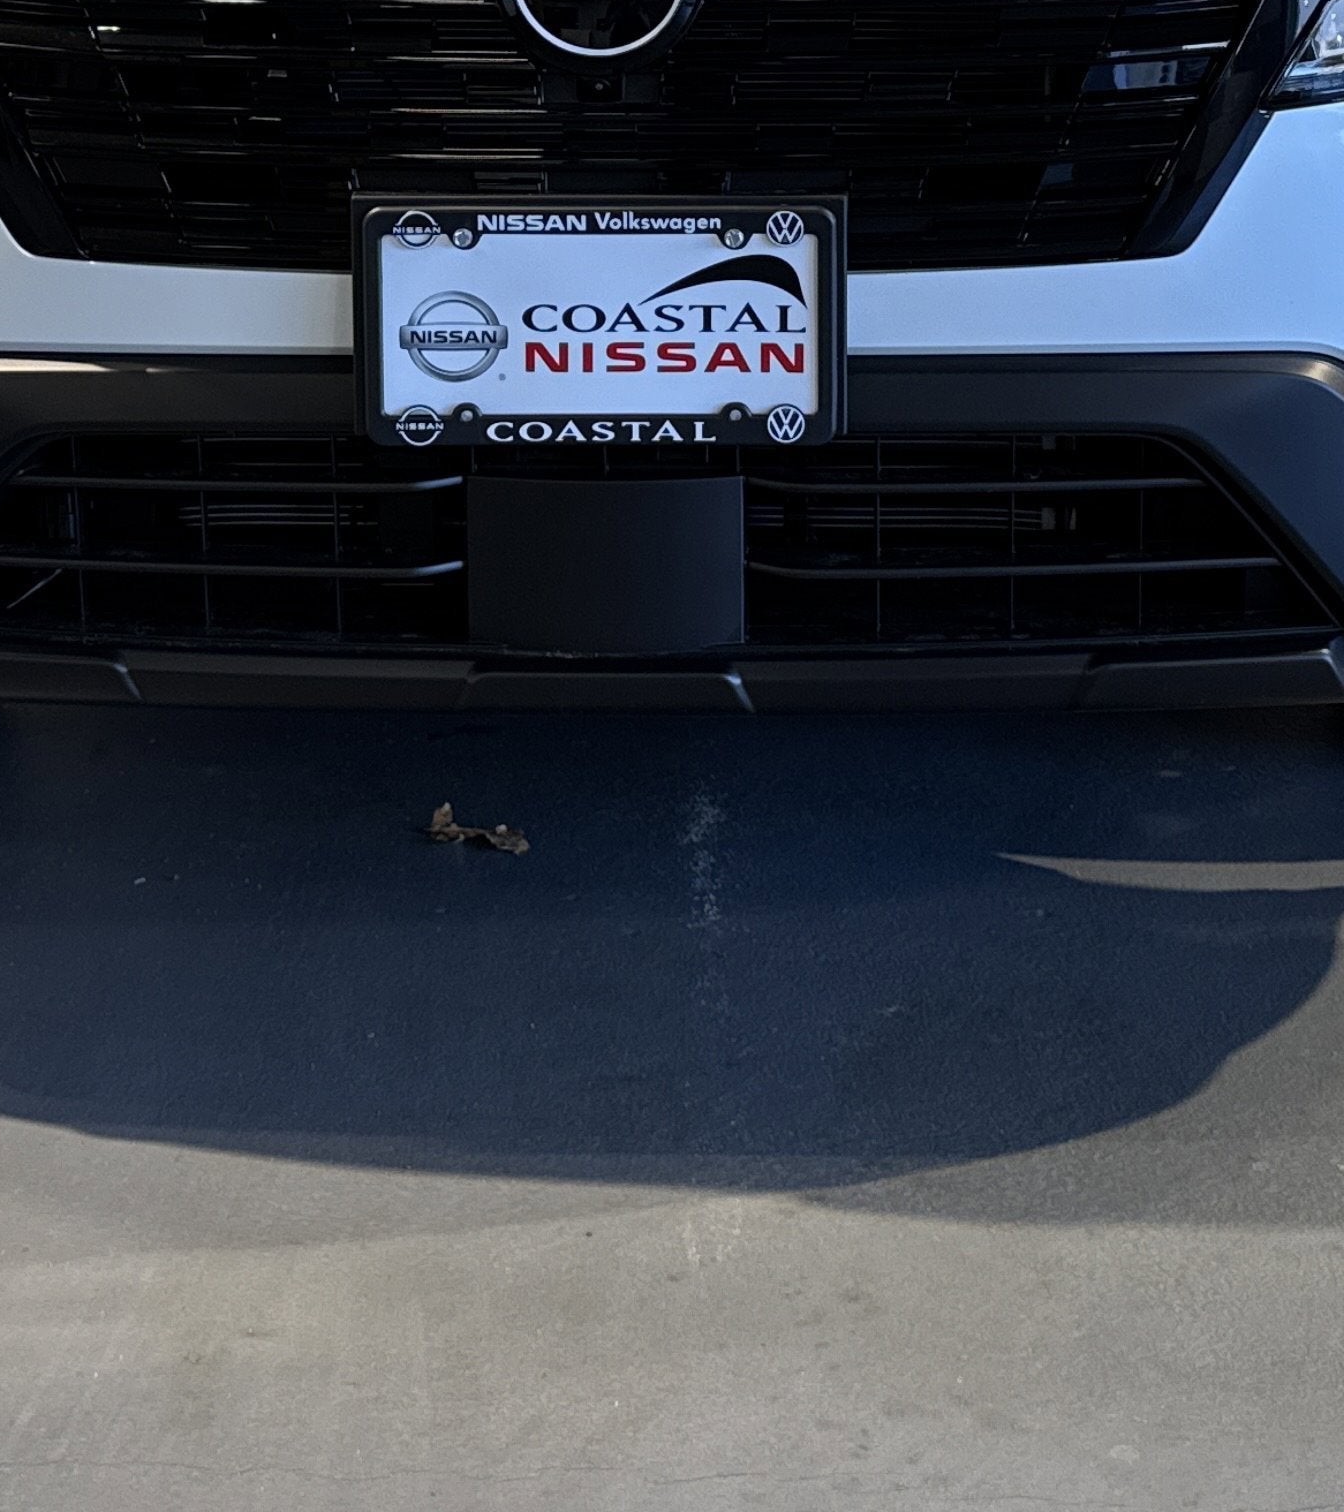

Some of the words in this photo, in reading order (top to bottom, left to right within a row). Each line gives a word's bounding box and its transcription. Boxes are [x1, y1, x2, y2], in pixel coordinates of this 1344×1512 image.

[392, 226, 441, 234] NISSAN
[477, 214, 587, 231] NISSAN
[594, 211, 721, 234] Volkswagen
[521, 303, 807, 334] COASTAL
[410, 330, 497, 344] NISSAN
[524, 342, 805, 373] NISSAN
[395, 422, 444, 430] NISSAN
[486, 420, 717, 443] COASTAL
